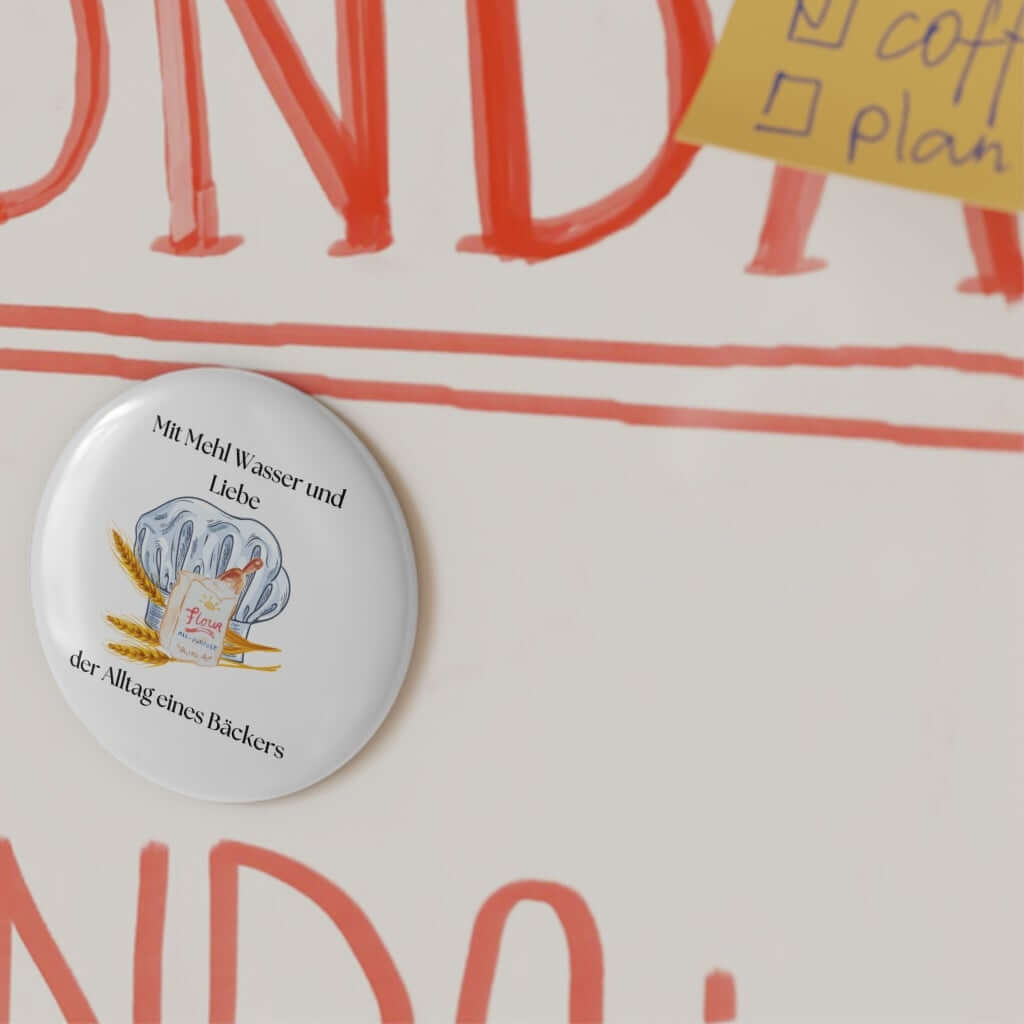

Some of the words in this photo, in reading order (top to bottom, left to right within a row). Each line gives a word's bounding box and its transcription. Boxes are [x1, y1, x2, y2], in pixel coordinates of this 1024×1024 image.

[846, 89, 1008, 174] plan
[153, 414, 182, 442] Mit
[184, 428, 232, 464] Mehl
[235, 447, 304, 492] Wasser
[305, 481, 347, 509] und
[209, 474, 262, 510] Liebe
[69, 650, 101, 677] der
[101, 666, 156, 708] Alltag
[156, 692, 205, 725] eines
[206, 711, 285, 760] Bäckers
